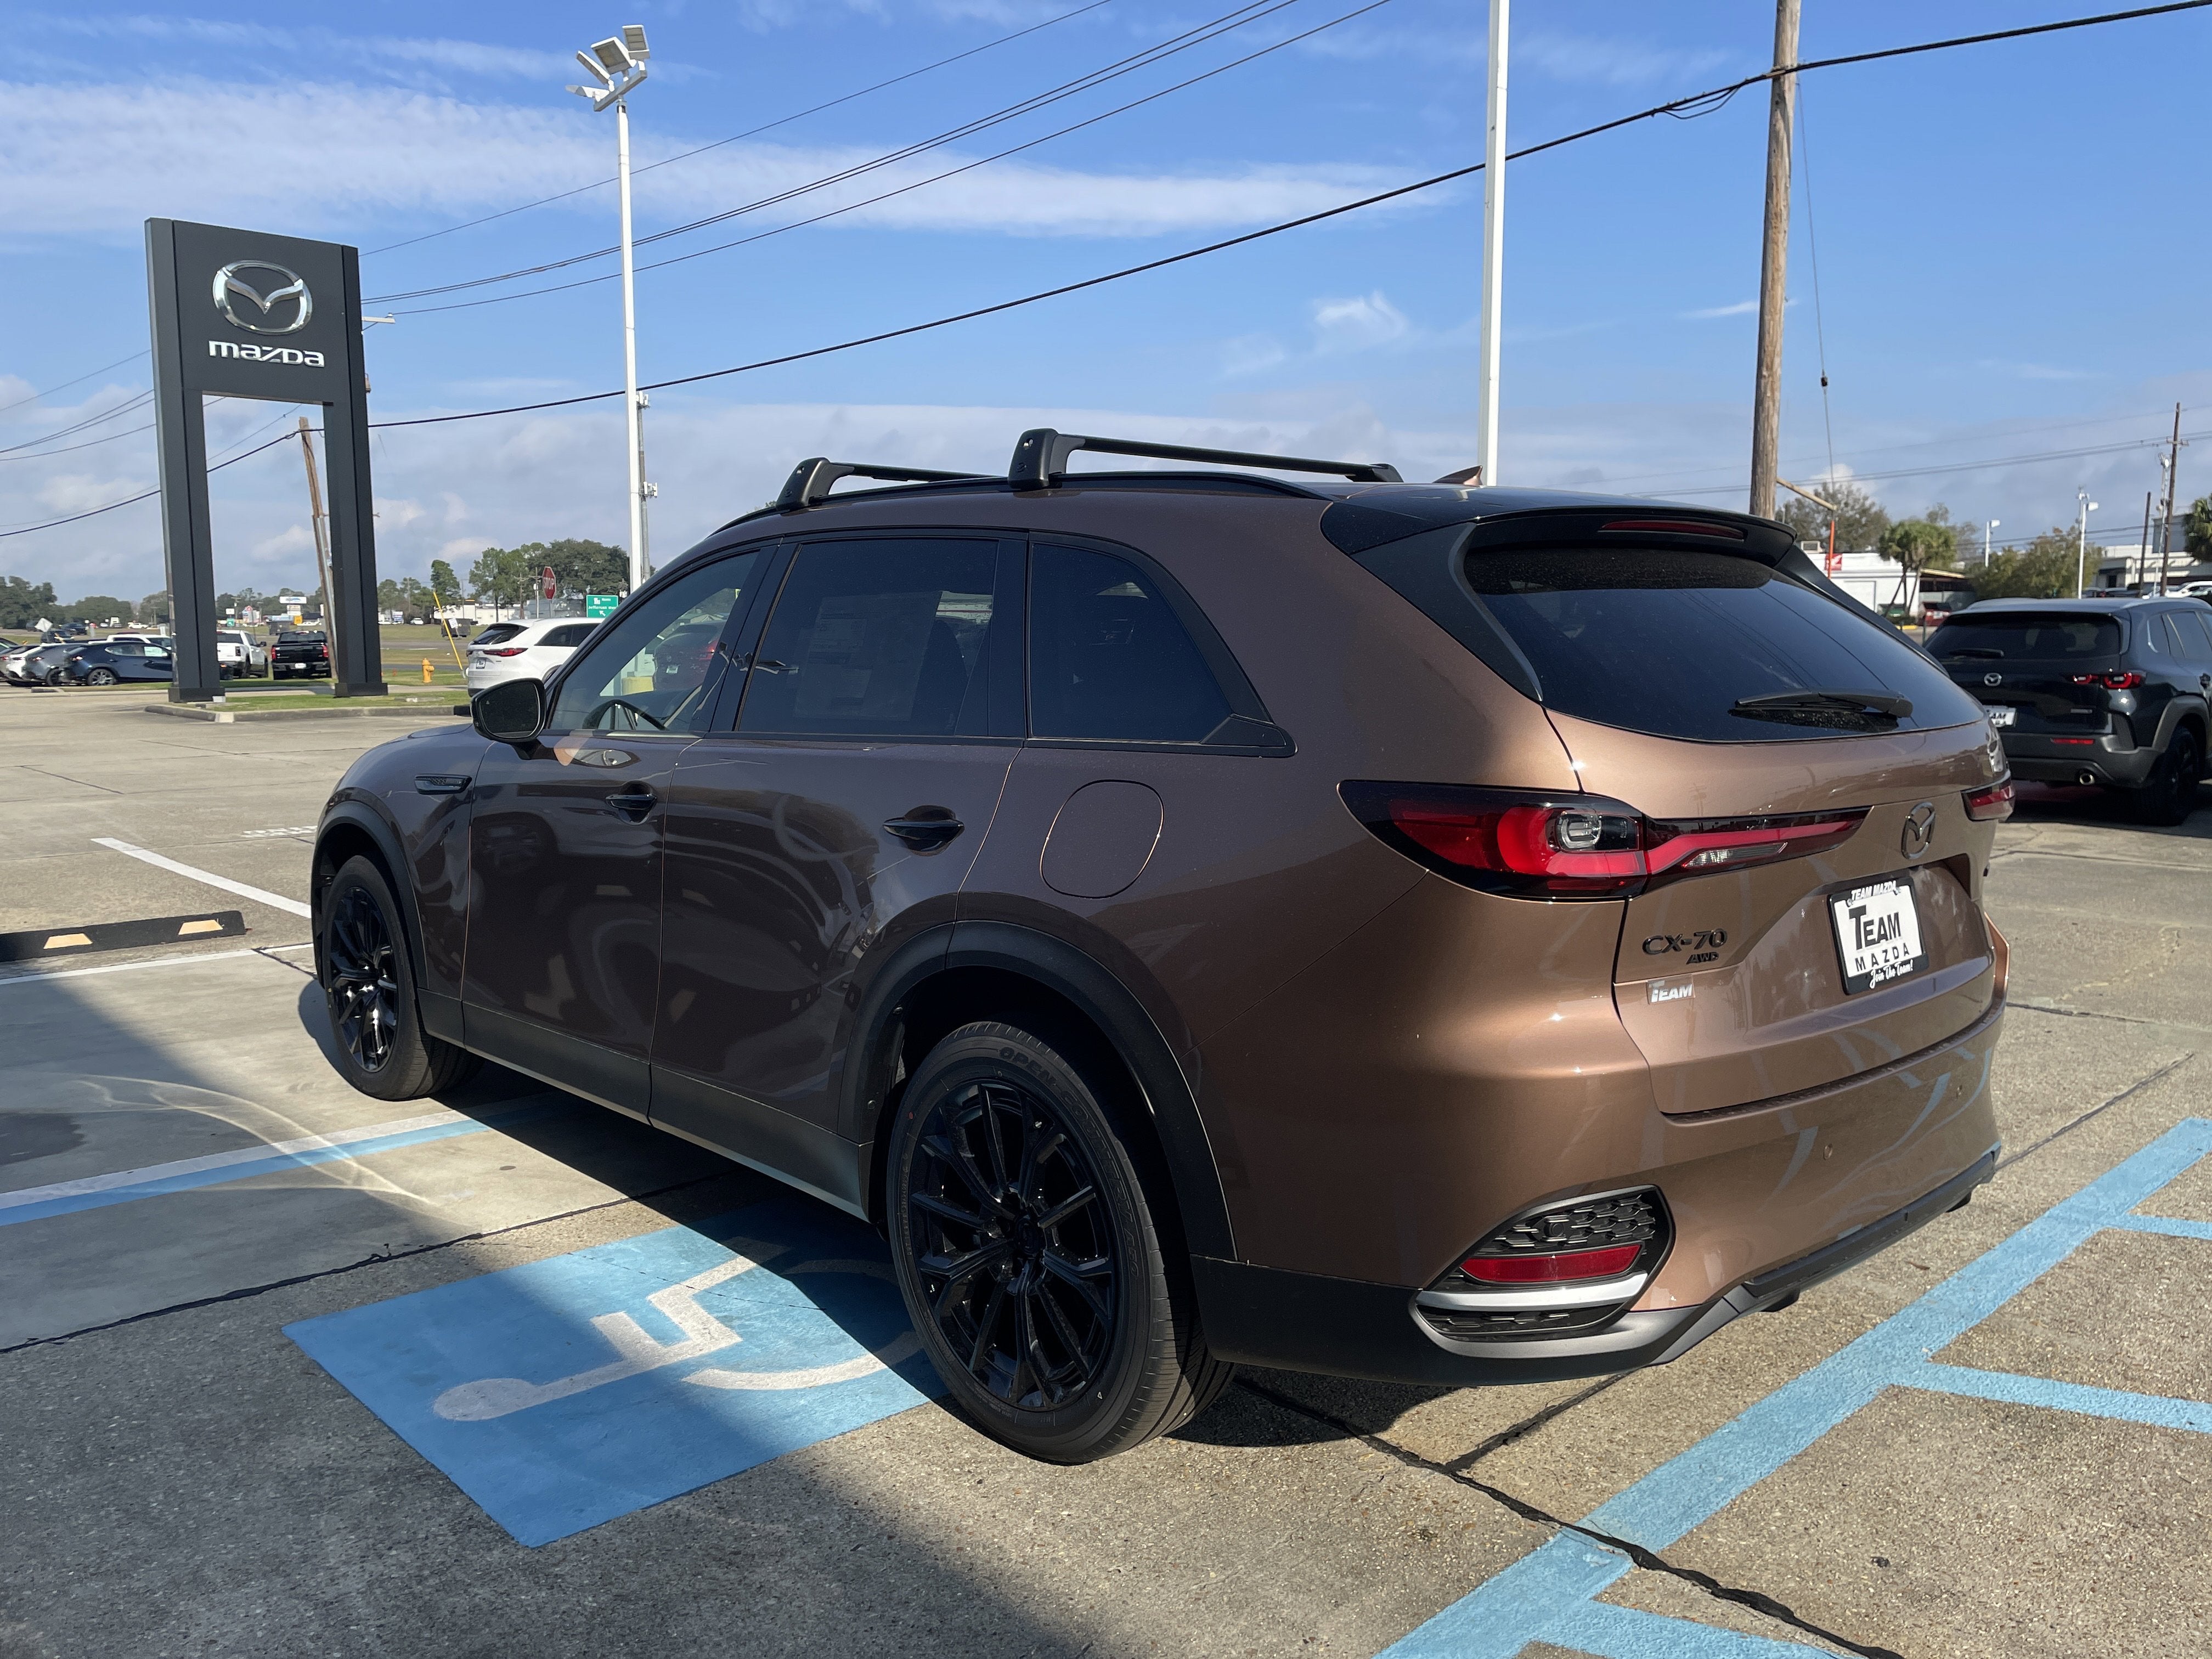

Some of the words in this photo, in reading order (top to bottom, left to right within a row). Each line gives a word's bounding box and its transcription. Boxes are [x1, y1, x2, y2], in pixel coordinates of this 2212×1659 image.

[543, 577, 555, 589] STOP
[1851, 886, 1872, 900] TEAM
[1873, 881, 1897, 895] MAZDA
[1642, 928, 1728, 955] CX-70
[1686, 951, 1719, 964] AWD
[1855, 943, 1909, 972] MAZDA
[1869, 967, 1884, 989] Join
[1883, 964, 1895, 980] The
[1894, 960, 1914, 977] Team!
[1000, 1047, 1058, 1086] OPEN
